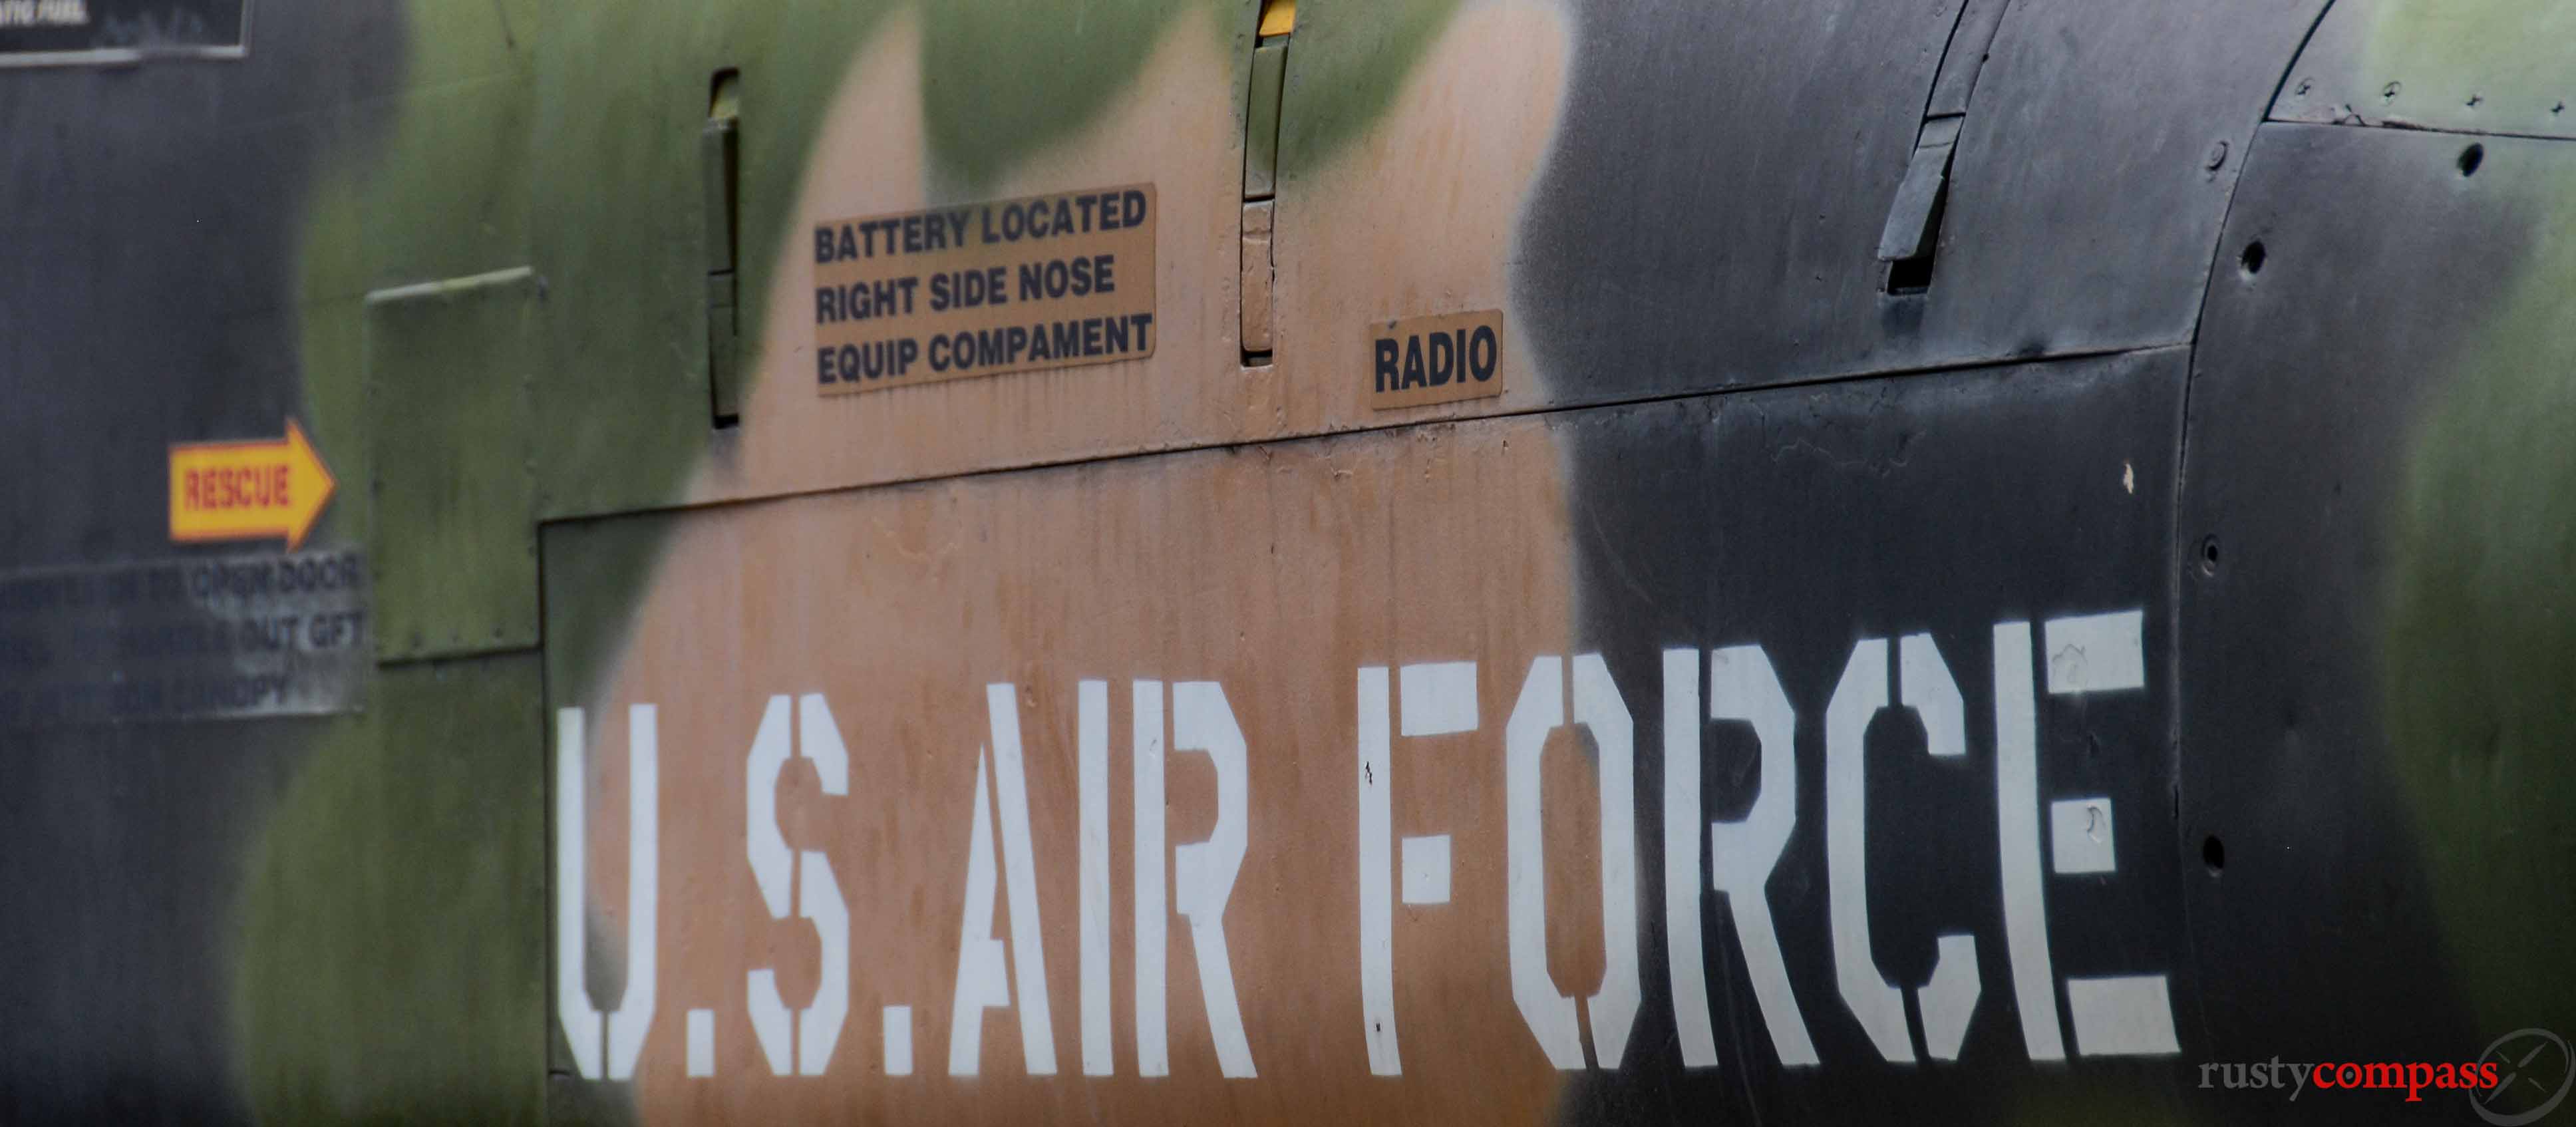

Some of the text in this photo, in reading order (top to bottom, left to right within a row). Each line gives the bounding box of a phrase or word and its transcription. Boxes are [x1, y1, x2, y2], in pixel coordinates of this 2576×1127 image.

[814, 190, 1147, 264] BATTERY LOCATED
[816, 254, 1115, 324] RIGHT SIDE NOSE
[818, 313, 1153, 385] EQUIP COMPAMENT
[1375, 325, 1497, 393] RADIO
[184, 465, 289, 510] RESCUE
[278, 554, 361, 593] DOOR
[1357, 610, 2181, 1077] FORCE
